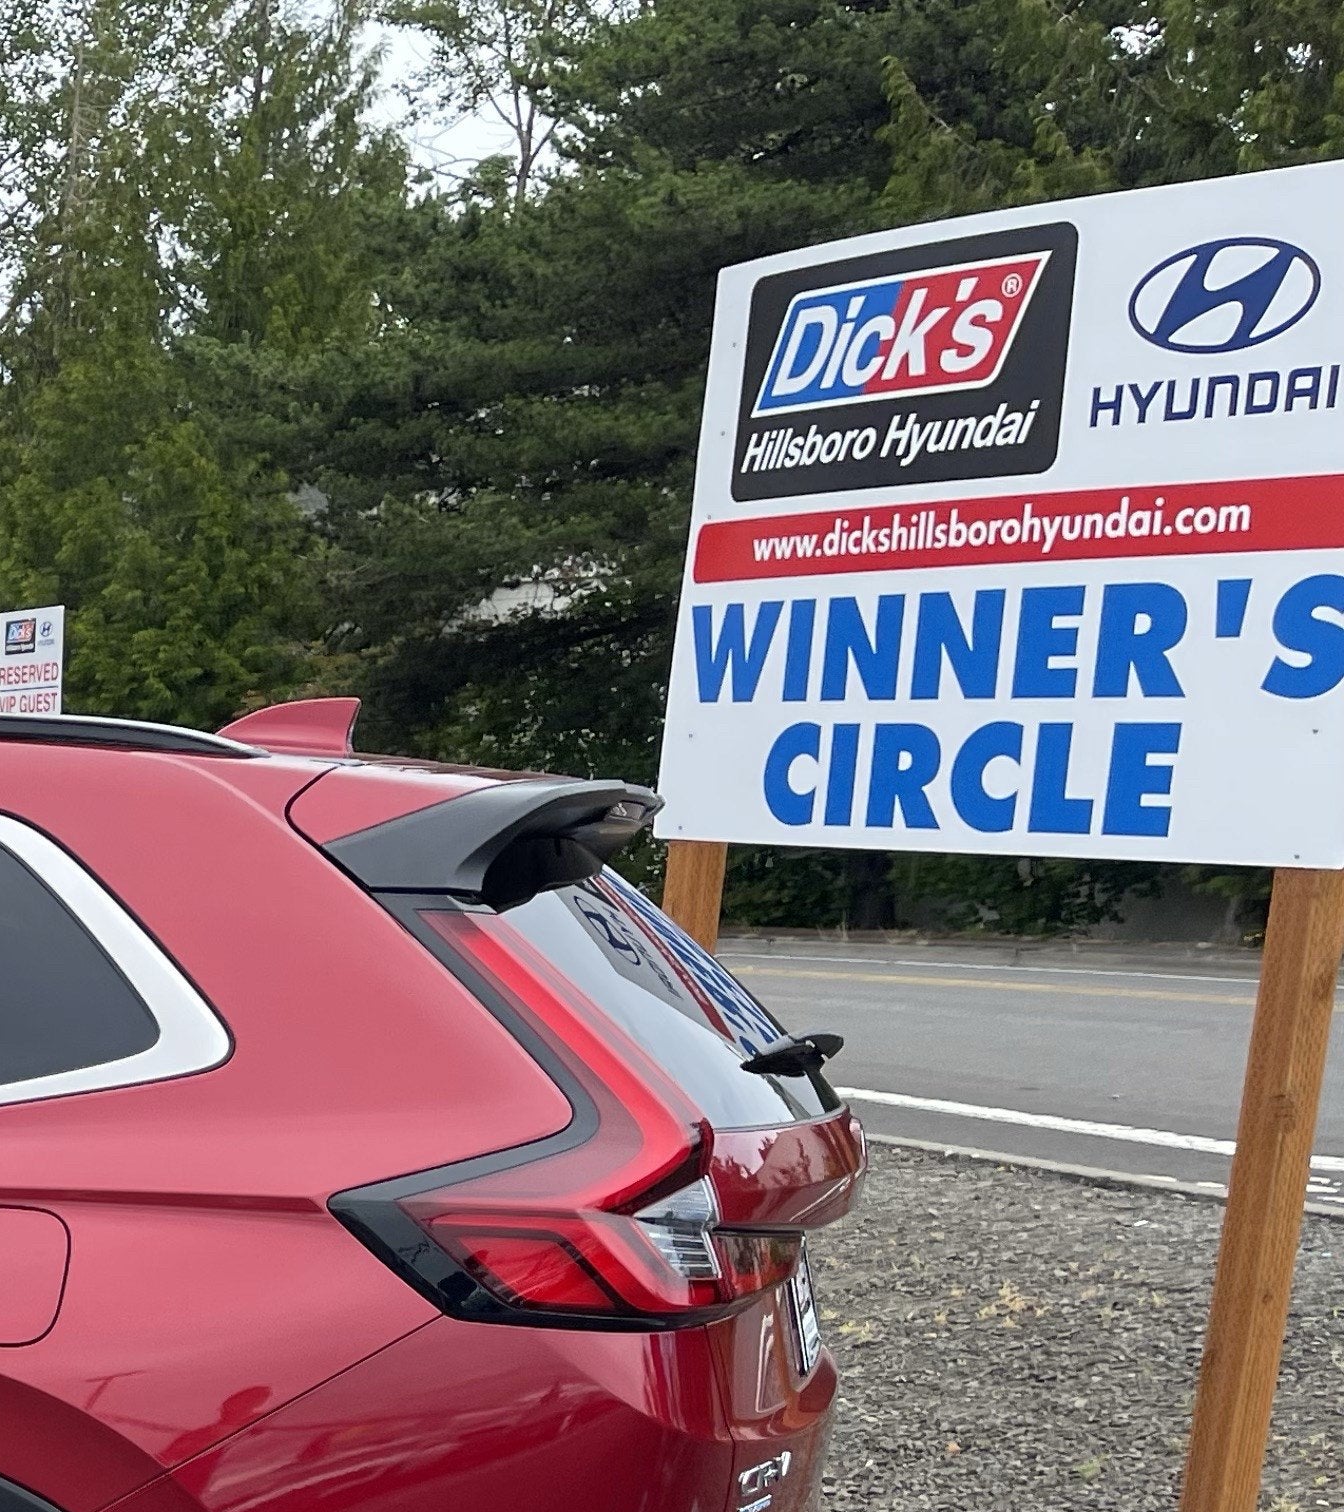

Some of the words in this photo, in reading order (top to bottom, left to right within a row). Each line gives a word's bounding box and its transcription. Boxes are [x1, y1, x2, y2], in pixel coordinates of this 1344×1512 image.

[1089, 365, 1340, 428] HYUNDAI
[740, 425, 877, 473] Hillsboro
[880, 399, 1040, 467] Hyundai
[752, 497, 1251, 561] www.dickshillsborohyundai.com
[692, 574, 1344, 703] WINNER'S
[0, 662, 59, 686] RESERVED
[0, 696, 16, 713] VIP
[20, 693, 57, 713] GUEST
[763, 721, 1183, 837] CIRCLE
